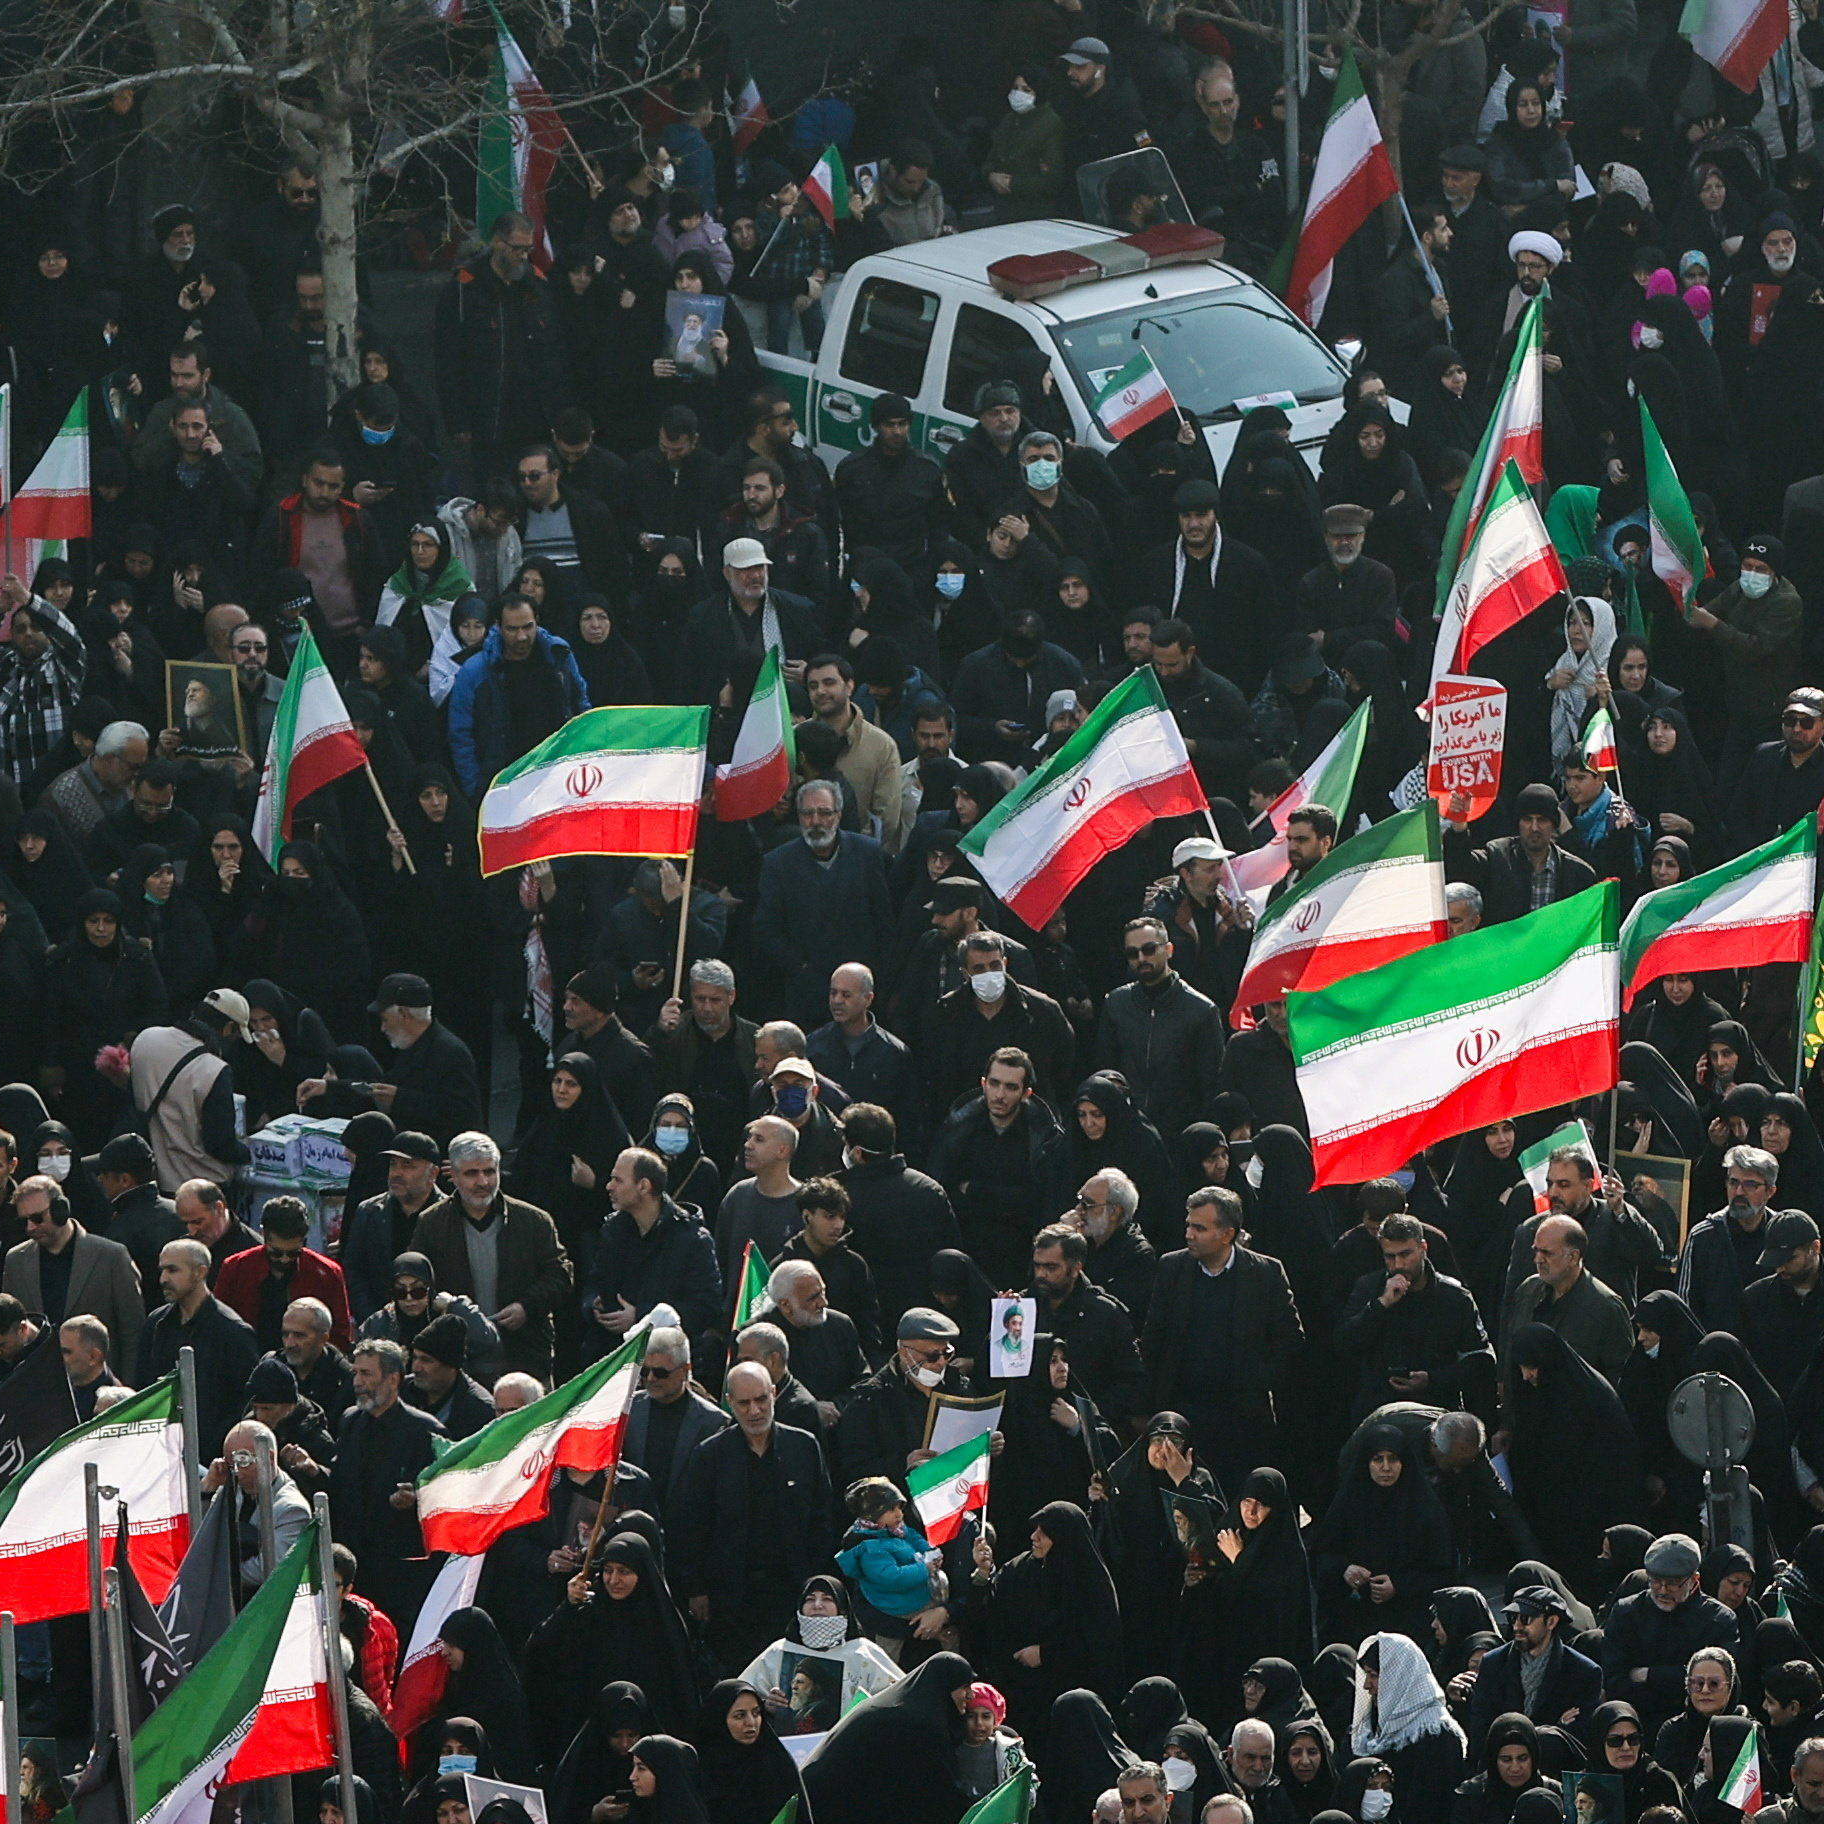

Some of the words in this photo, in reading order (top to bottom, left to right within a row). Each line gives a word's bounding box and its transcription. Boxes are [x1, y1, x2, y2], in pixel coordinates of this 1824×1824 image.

[1449, 702, 1486, 729] آمریکا
[1489, 703, 1502, 719] ما
[1438, 713, 1449, 733] را
[1490, 729, 1503, 744] زیر
[1441, 755, 1468, 768] DOWN
[1469, 752, 1492, 764] WITH
[1441, 763, 1496, 790] USA
